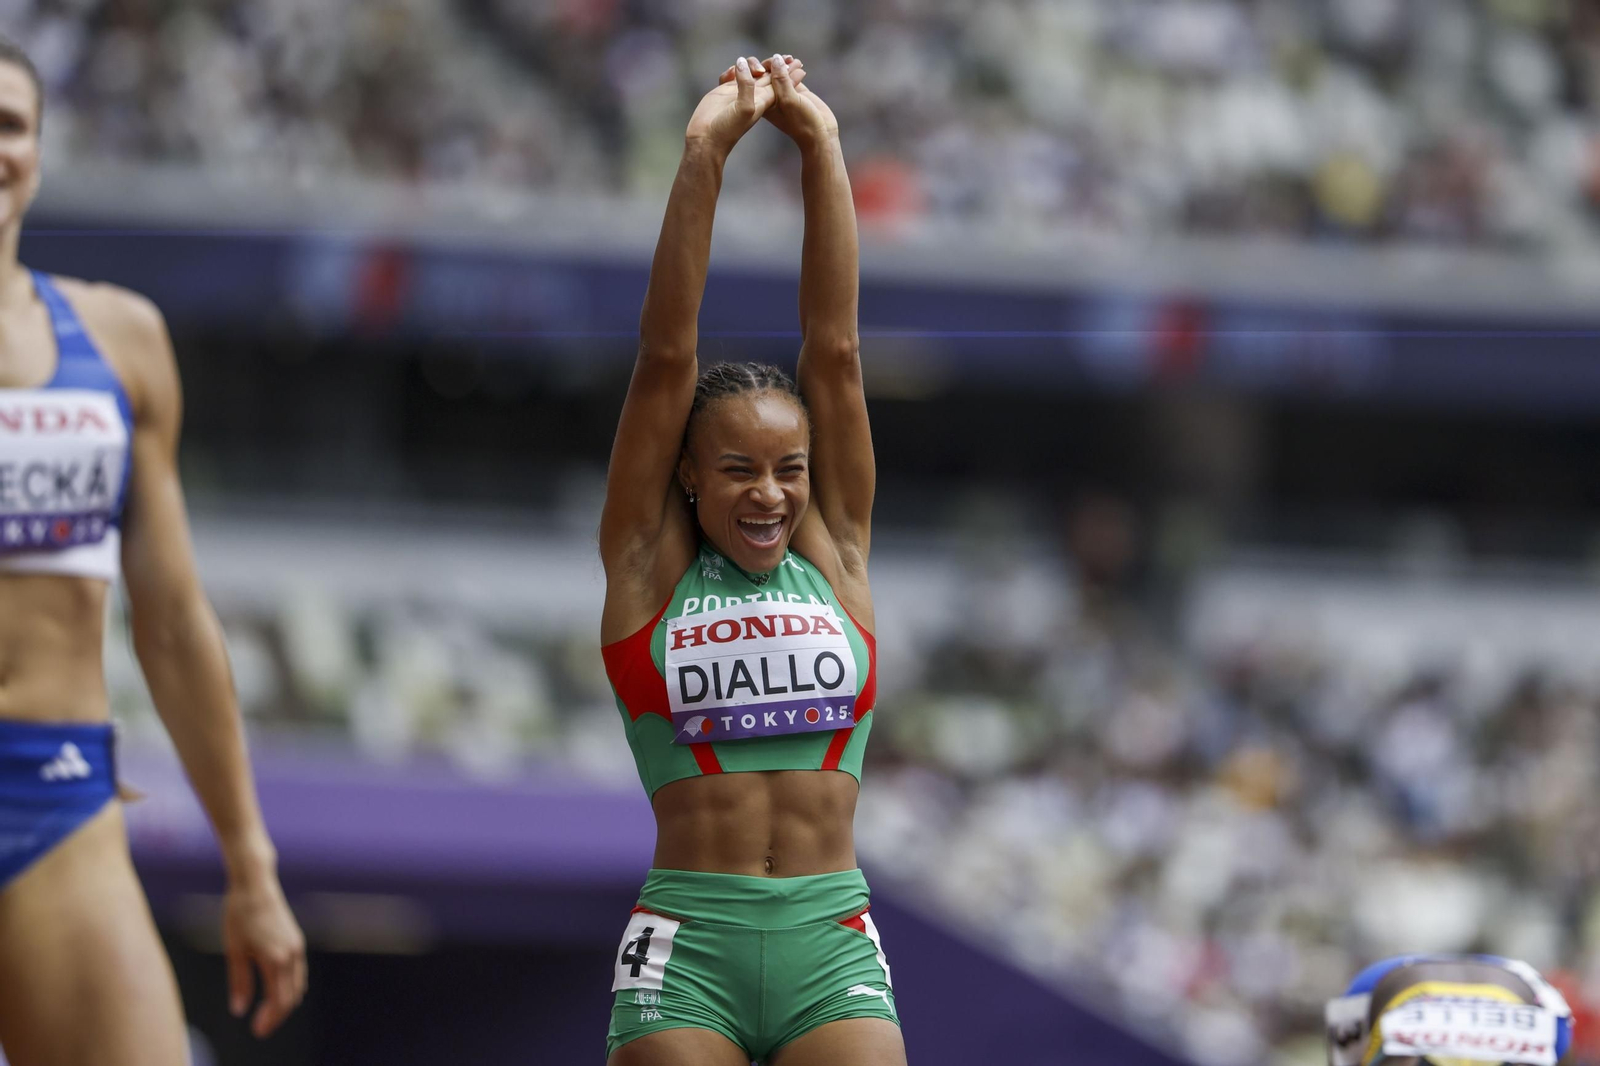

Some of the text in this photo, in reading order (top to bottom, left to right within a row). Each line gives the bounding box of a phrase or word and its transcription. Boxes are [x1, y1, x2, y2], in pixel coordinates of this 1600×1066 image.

[702, 570, 723, 581] FPA
[670, 614, 842, 651] HONDA
[678, 651, 845, 704] DIALLO
[621, 926, 655, 978] 4
[640, 1010, 663, 1022] FPA
